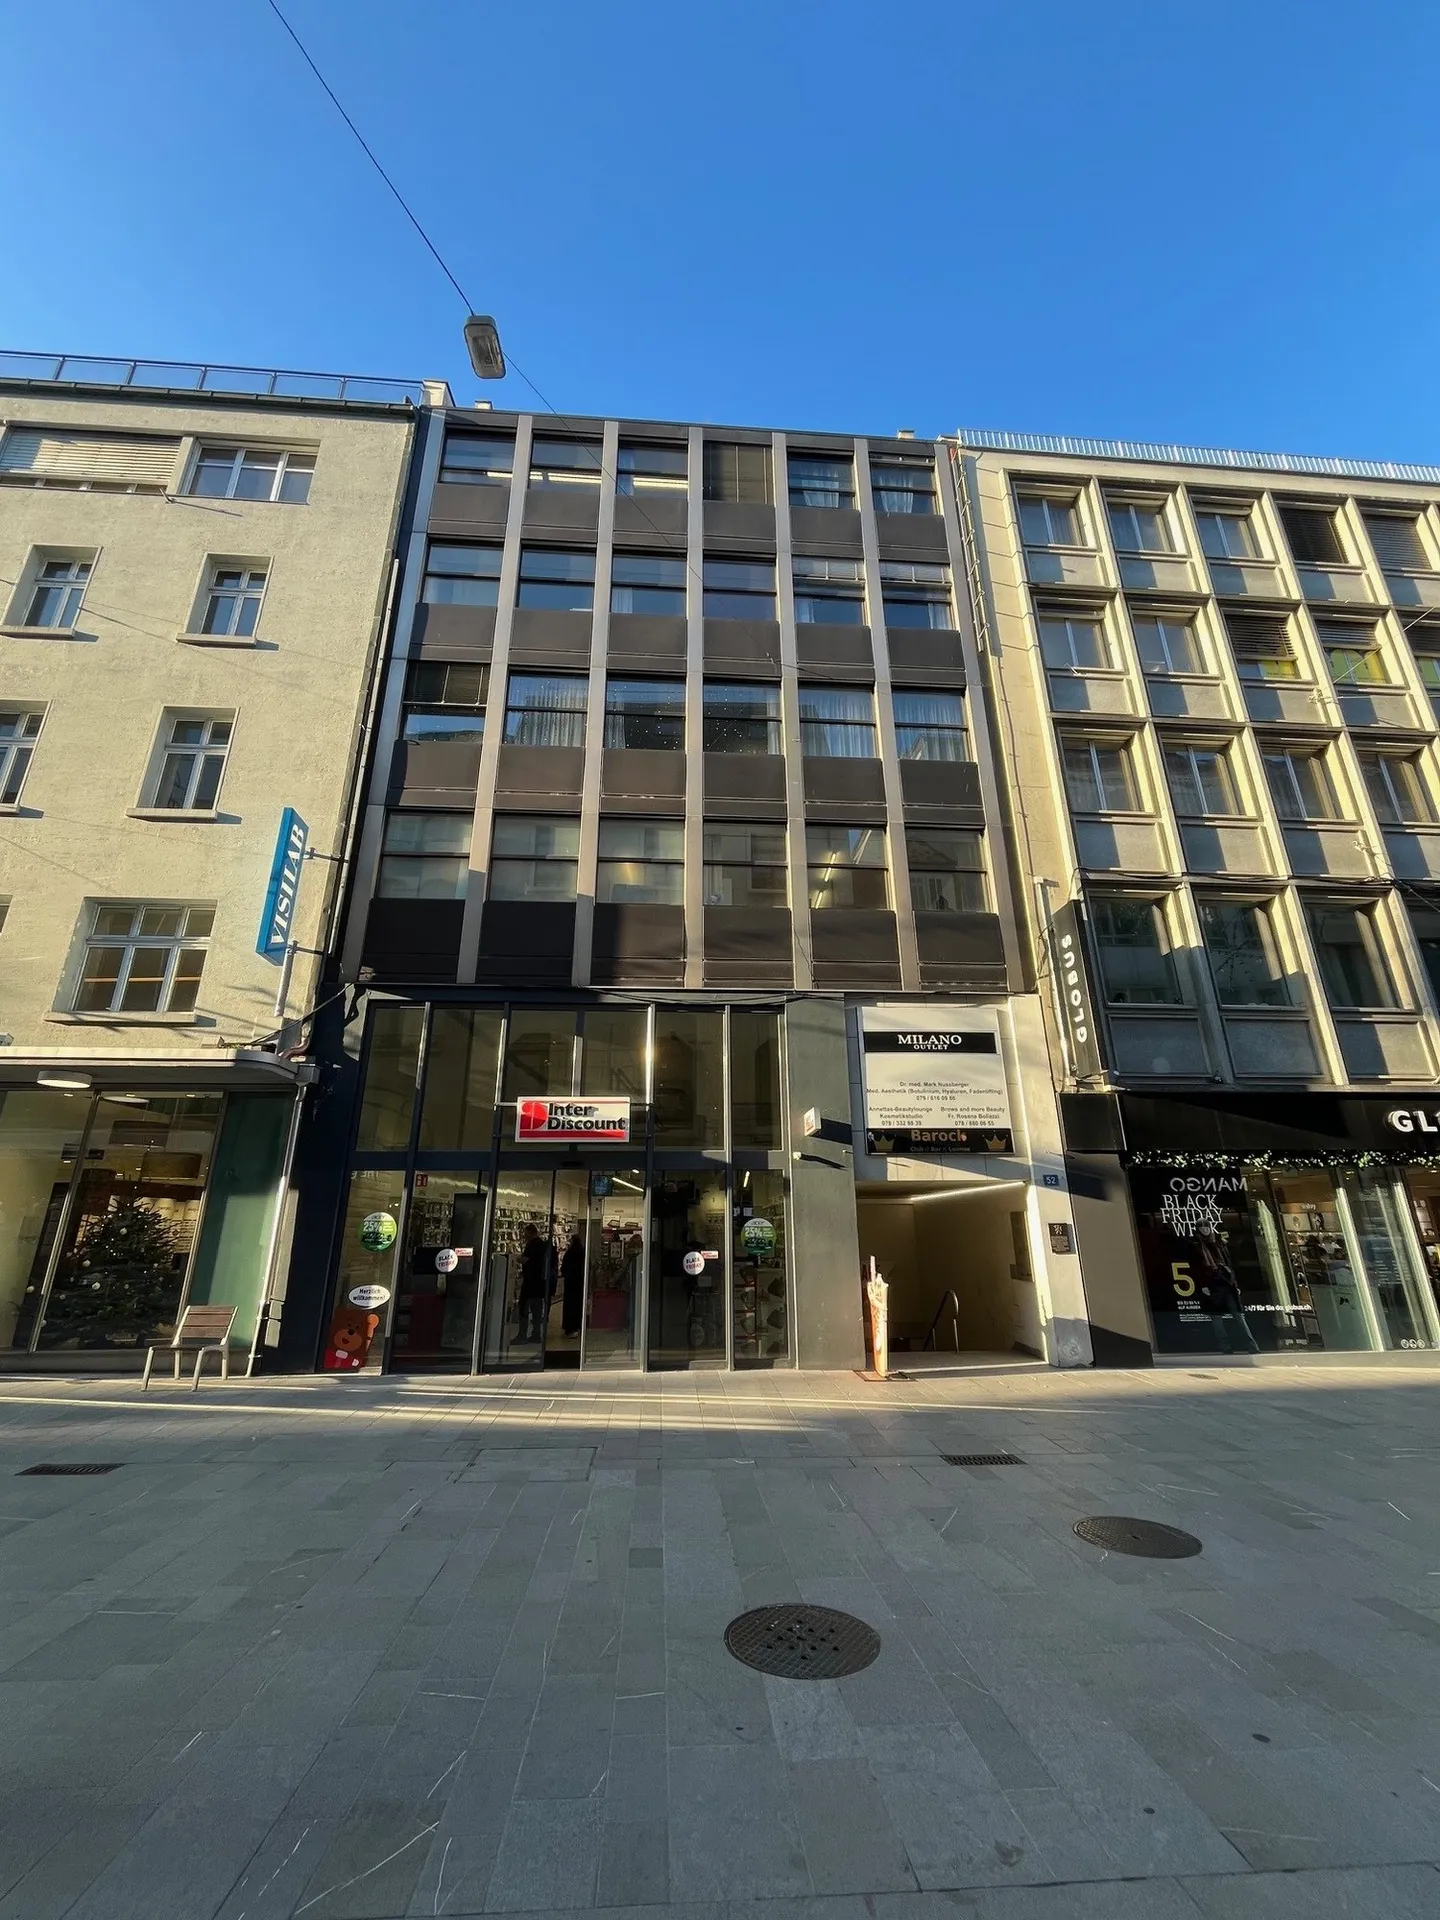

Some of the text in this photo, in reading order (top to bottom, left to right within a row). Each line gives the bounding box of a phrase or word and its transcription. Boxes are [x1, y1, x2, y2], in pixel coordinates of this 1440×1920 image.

[270, 824, 304, 944] VISILAB
[1061, 934, 1088, 1043] GLOBUS
[897, 1034, 963, 1045] MILANO
[549, 1102, 595, 1116] Inter
[547, 1116, 626, 1130] Discount
[1046, 1176, 1056, 1185] 52
[1162, 1194, 1219, 1210] BLACK
[1160, 1208, 1223, 1224] FRIDAY
[363, 1221, 383, 1232] 25%
[744, 1227, 763, 1237] 25%
